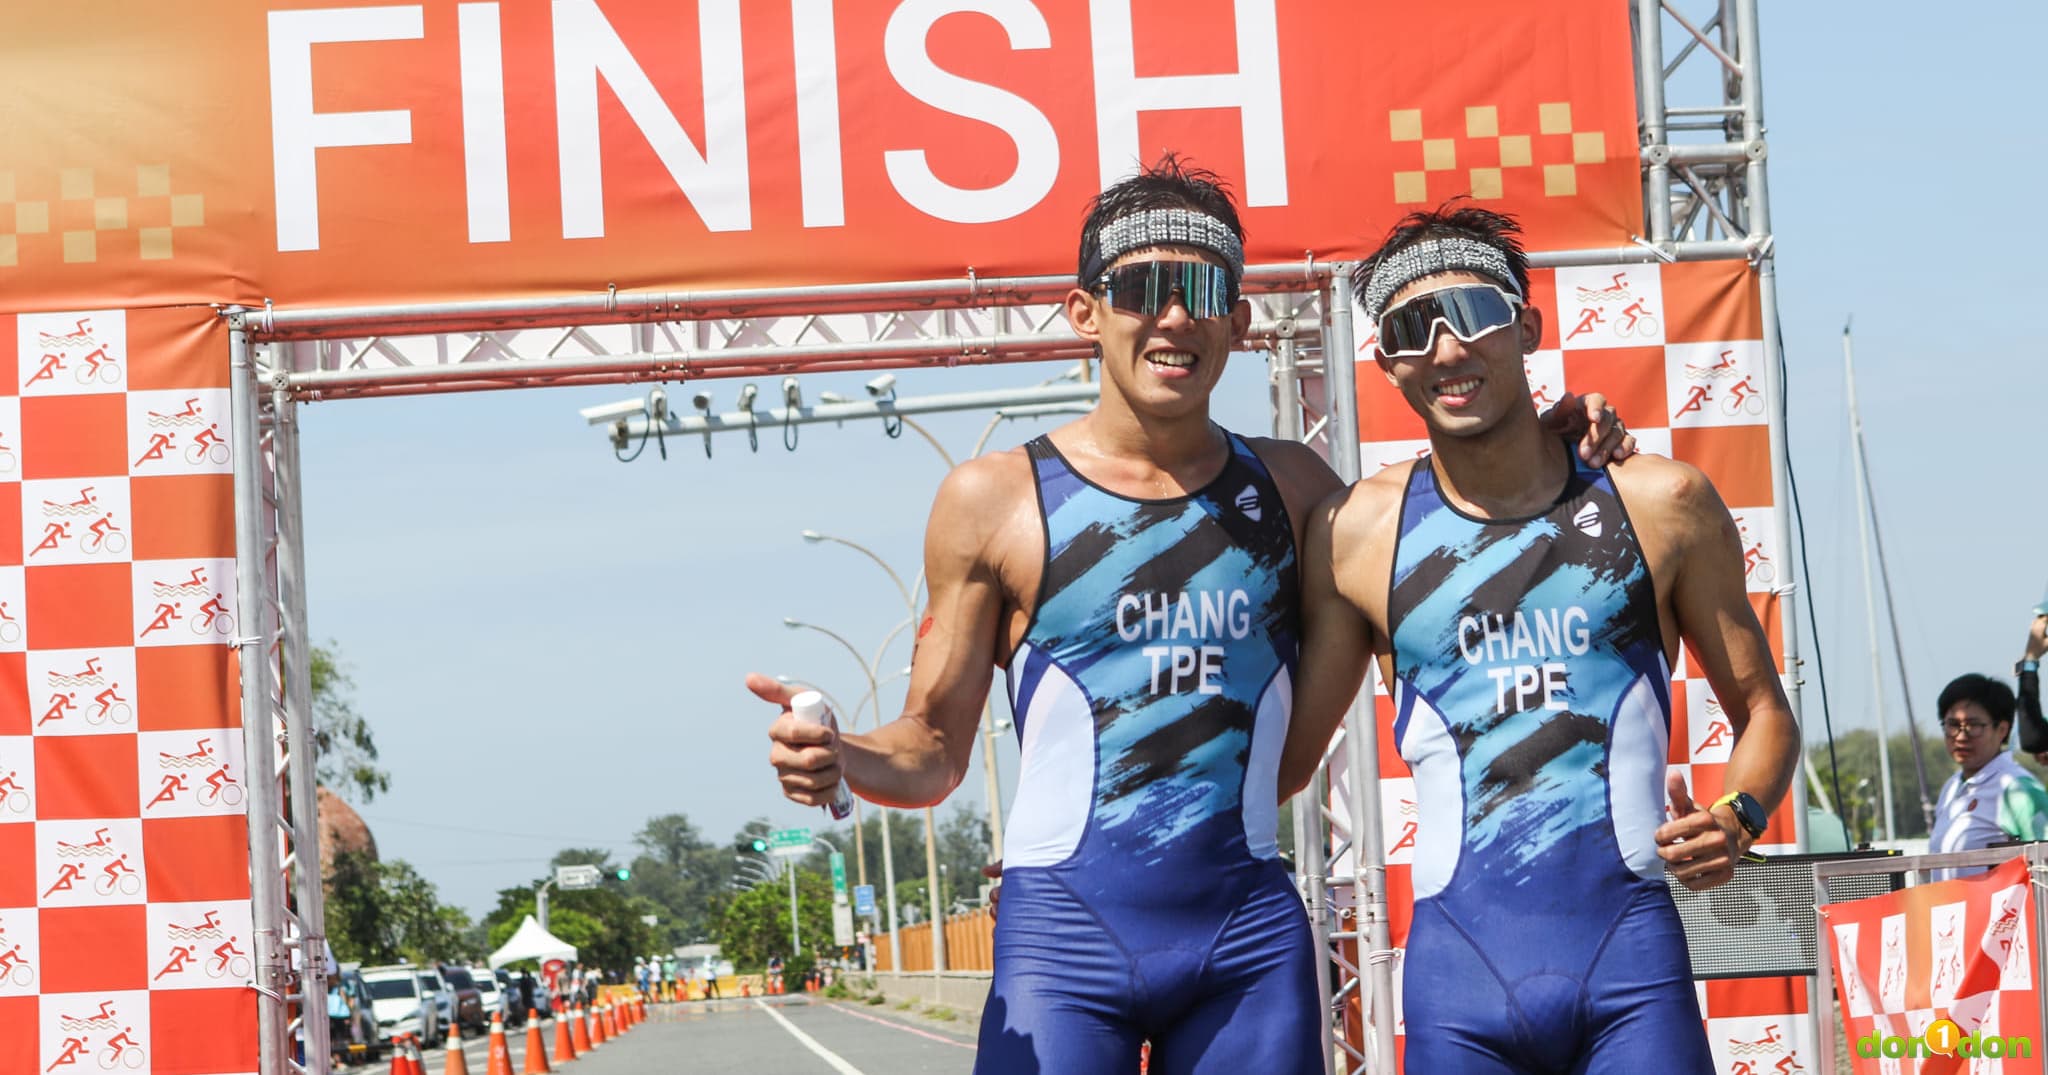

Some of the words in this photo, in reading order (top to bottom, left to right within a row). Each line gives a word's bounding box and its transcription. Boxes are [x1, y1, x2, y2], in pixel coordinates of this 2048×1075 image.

[267, 0, 1289, 252] FINISH
[1115, 588, 1251, 643] CHANG
[1457, 605, 1591, 665] CHANG
[1142, 645, 1226, 696] TPE
[1486, 662, 1570, 714] TPE
